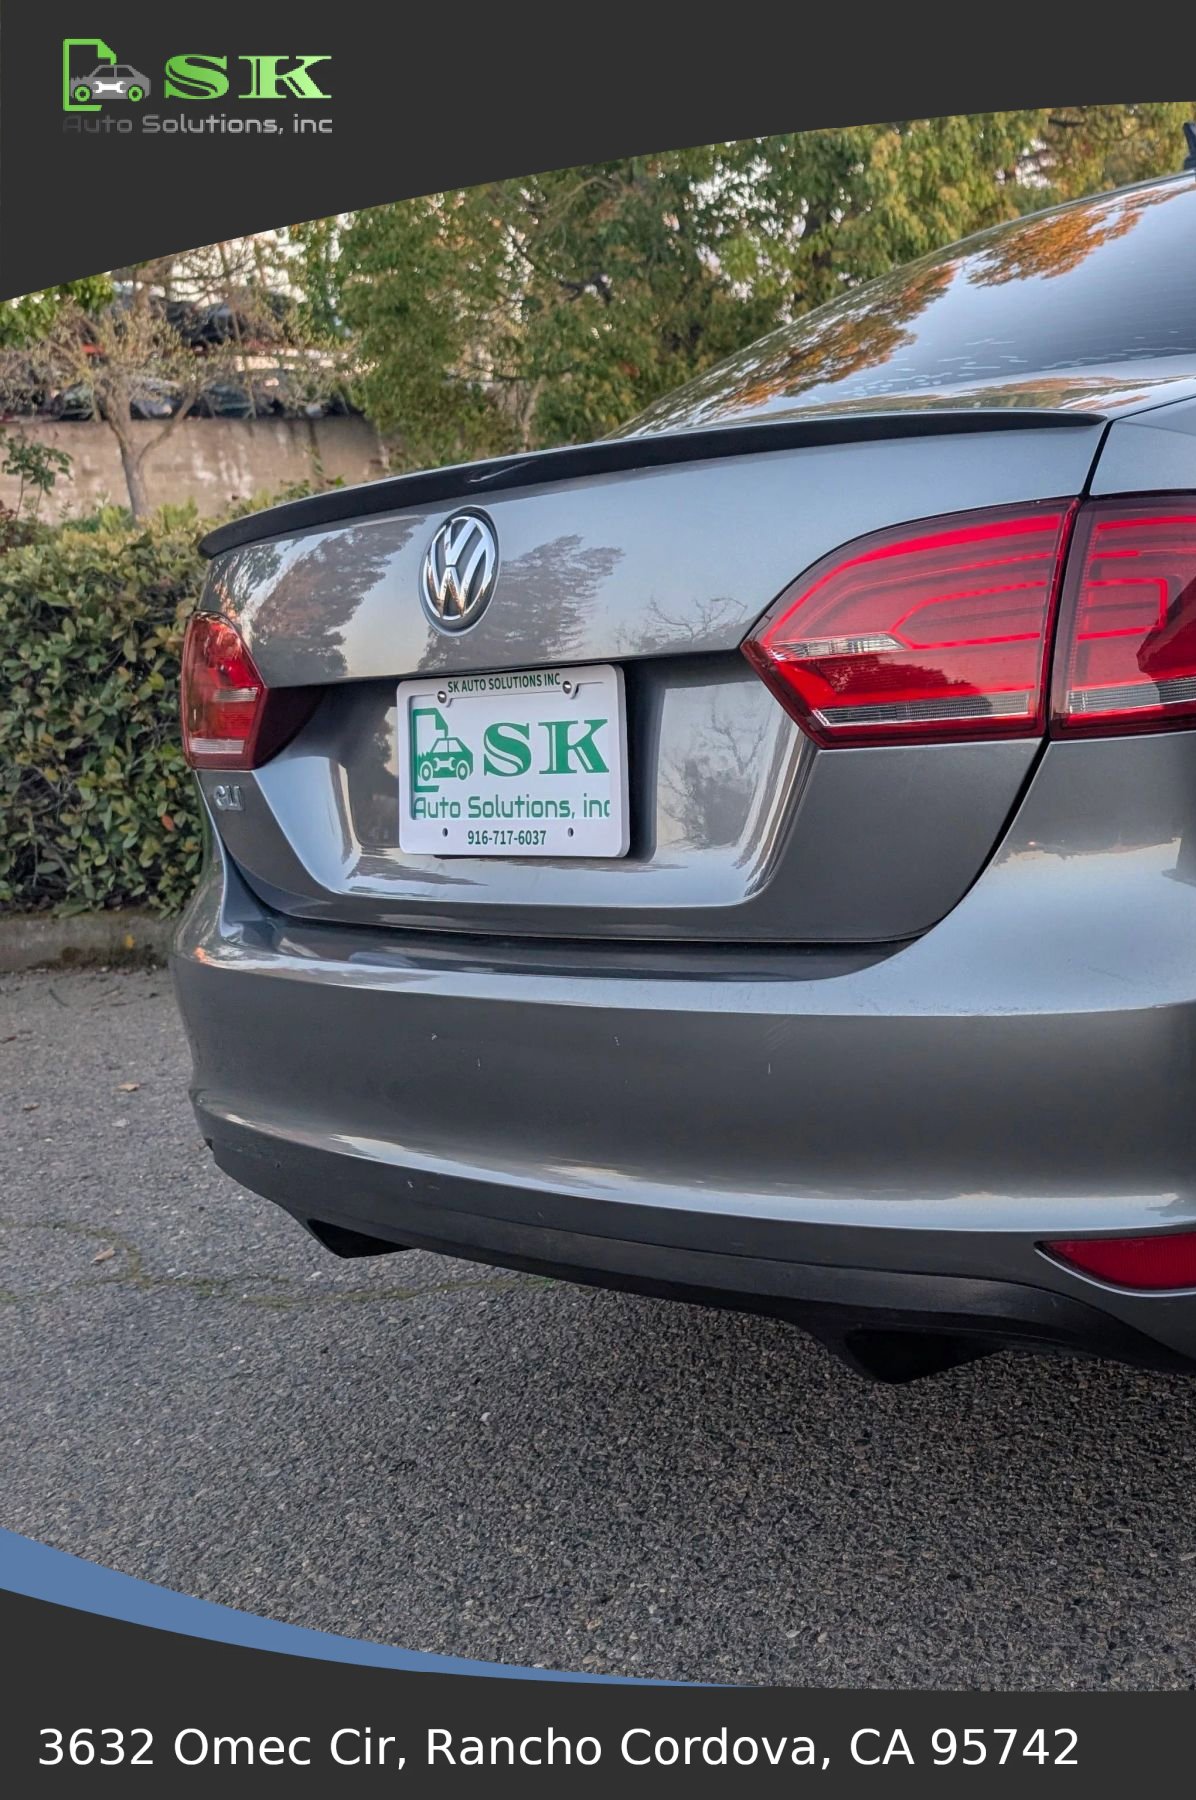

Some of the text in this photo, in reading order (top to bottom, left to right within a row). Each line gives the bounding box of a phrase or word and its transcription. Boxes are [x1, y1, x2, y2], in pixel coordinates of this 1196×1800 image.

[447, 672, 561, 693] SK AUTO SOLUTIONS INC
[483, 718, 610, 777] SK
[413, 796, 461, 819] Auto
[468, 794, 576, 820] Solutions,
[467, 829, 547, 846] 916-717-6037
